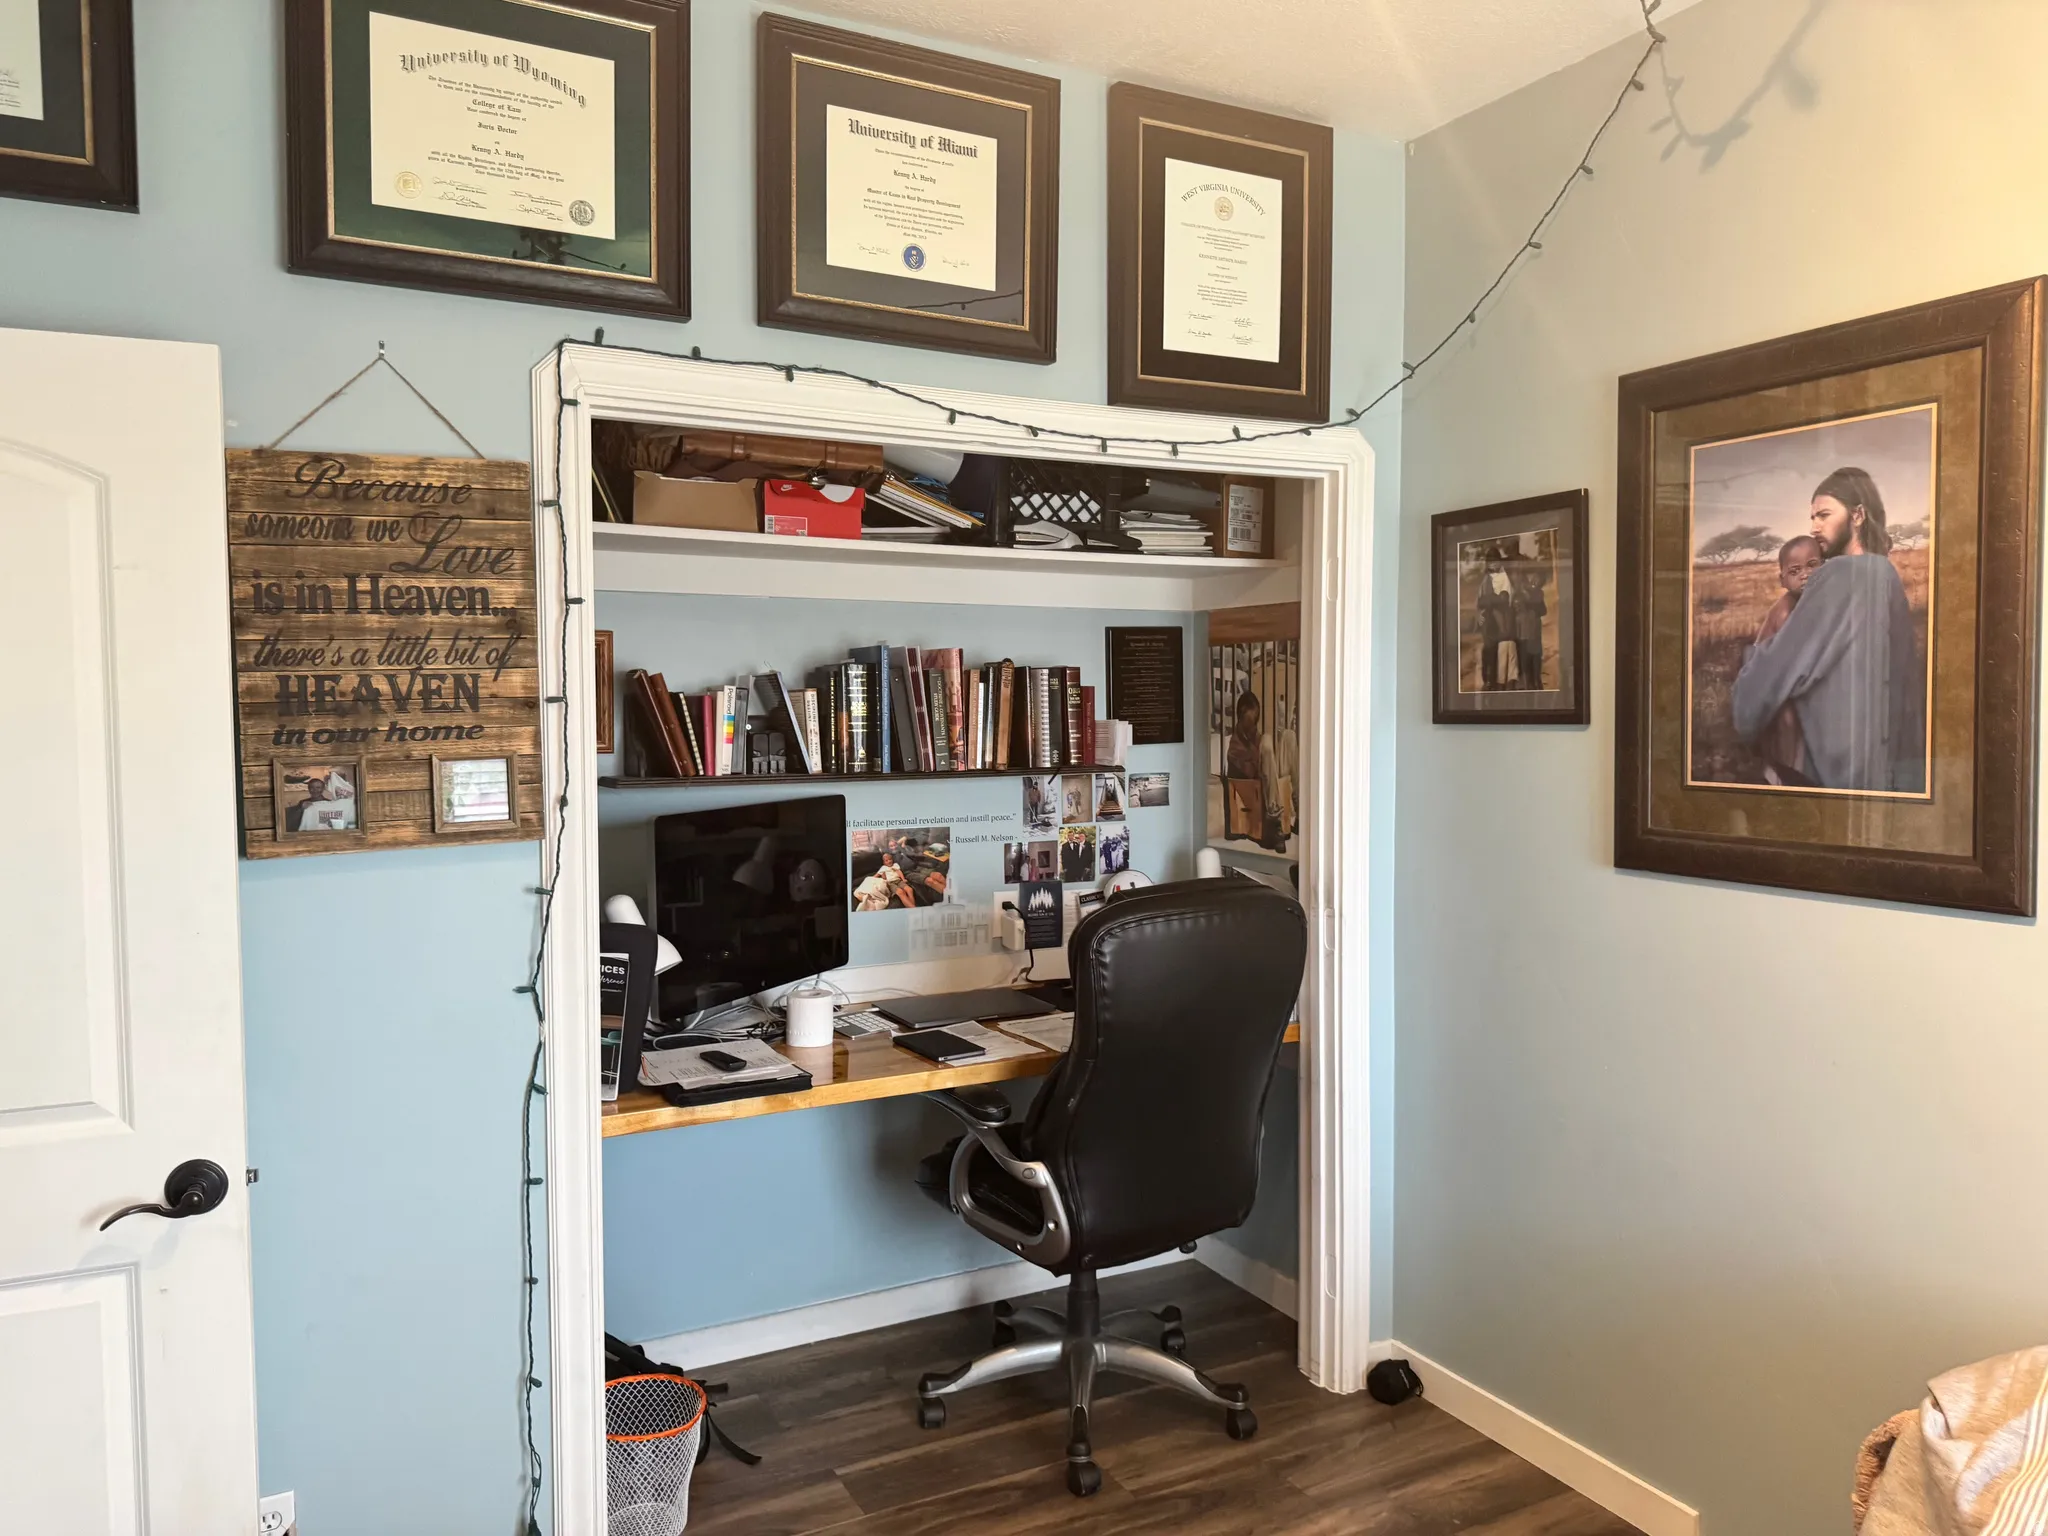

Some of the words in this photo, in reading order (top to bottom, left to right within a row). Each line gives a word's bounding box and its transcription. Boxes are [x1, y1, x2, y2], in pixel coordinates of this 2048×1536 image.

[399, 49, 488, 73] University
[493, 55, 508, 68] of
[512, 53, 586, 109] Wyoming
[472, 99, 495, 109] College
[507, 105, 521, 113] Law
[477, 122, 495, 131] Juris
[497, 125, 518, 135] Doctor
[848, 118, 917, 149] University
[920, 136, 935, 149] of
[937, 136, 978, 158] Miami
[471, 144, 492, 155] Kenny
[505, 150, 525, 161] Hardy
[893, 169, 910, 179] Kenny
[920, 174, 936, 184] Hardy
[917, 196, 935, 205] Property
[1181, 186, 1198, 202] WEST
[1199, 183, 1229, 192] VIRGINIA
[1230, 186, 1266, 216] UNIVERSITY
[285, 457, 473, 506] Because
[366, 518, 403, 542] we
[388, 510, 516, 575] Love
[251, 569, 284, 615] is
[294, 570, 335, 615] in
[343, 572, 518, 617] Heaven...
[254, 628, 344, 667] there's
[350, 647, 370, 666] a
[377, 628, 438, 668] little
[444, 628, 485, 666] bit
[485, 632, 522, 682] of
[275, 667, 482, 717] HEAVEN
[272, 724, 306, 745] in
[311, 727, 379, 744] our
[384, 721, 485, 742] home
[852, 819, 884, 828] facilitate
[886, 817, 917, 828] personal
[918, 815, 955, 825] revelation
[955, 814, 969, 823] and
[970, 814, 990, 822] instill
[991, 834, 1014, 842] Nelson
[600, 964, 625, 975] ICES
